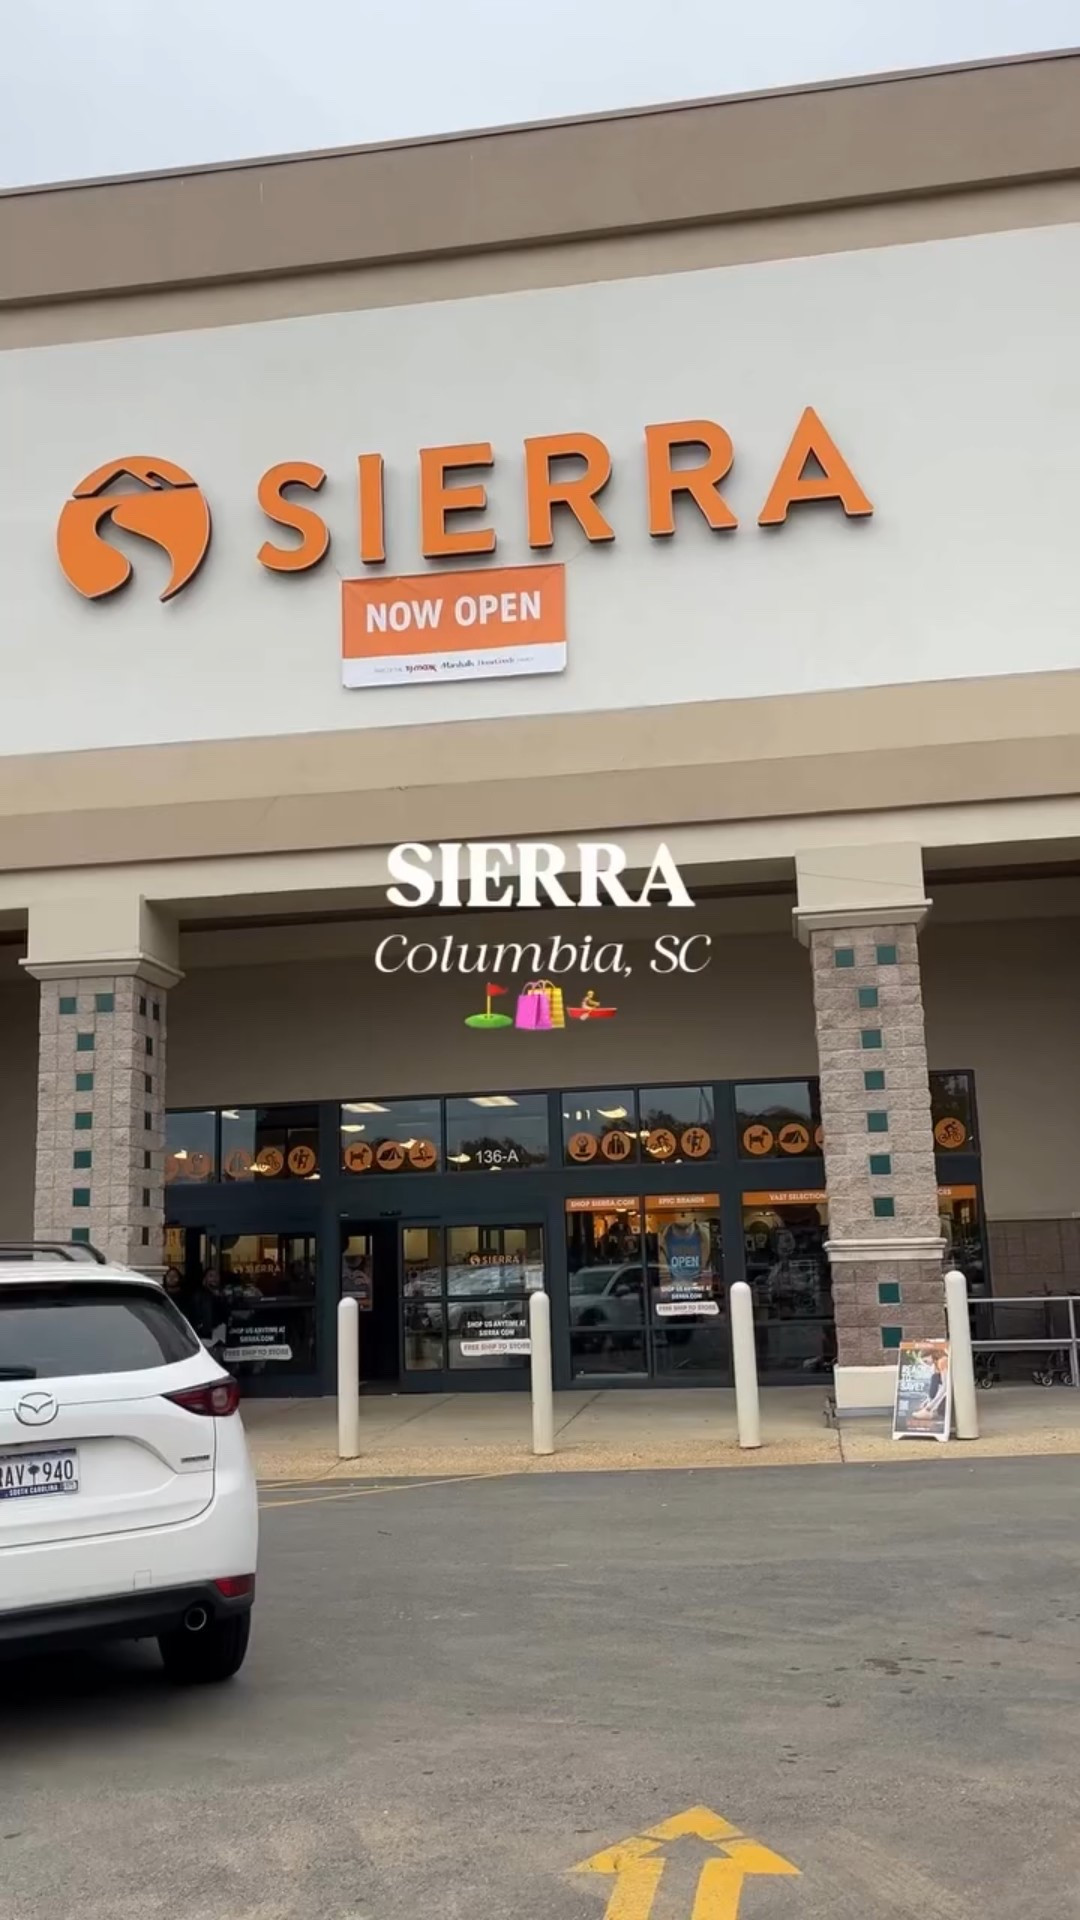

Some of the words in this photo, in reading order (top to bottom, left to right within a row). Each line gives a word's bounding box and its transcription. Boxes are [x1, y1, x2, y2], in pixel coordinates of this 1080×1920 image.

[256, 406, 874, 573] SIERRA
[366, 598, 443, 633] NOW
[454, 591, 541, 627] OPEN
[475, 1149, 520, 1164] 136-A
[676, 1196, 705, 1204] BRANDS
[768, 1193, 787, 1201] VAST
[788, 1192, 827, 1200] SELECTION
[592, 1199, 636, 1207] SIERRA.COM
[482, 1254, 520, 1265] SIERRA
[671, 1255, 700, 1269] OPEN
[245, 1263, 281, 1274] SIERRA
[467, 1321, 482, 1329] SHOP
[484, 1320, 493, 1328] US
[519, 1319, 527, 1327] AT
[463, 1343, 479, 1351] FREE
[481, 1343, 497, 1351] SHIP
[509, 1341, 531, 1350] STORE
[901, 1382, 925, 1391] SAVE?
[42, 1459, 74, 1482] 940
[9, 1487, 29, 1497] SOUTH
[30, 1484, 58, 1494] CAROLINA
